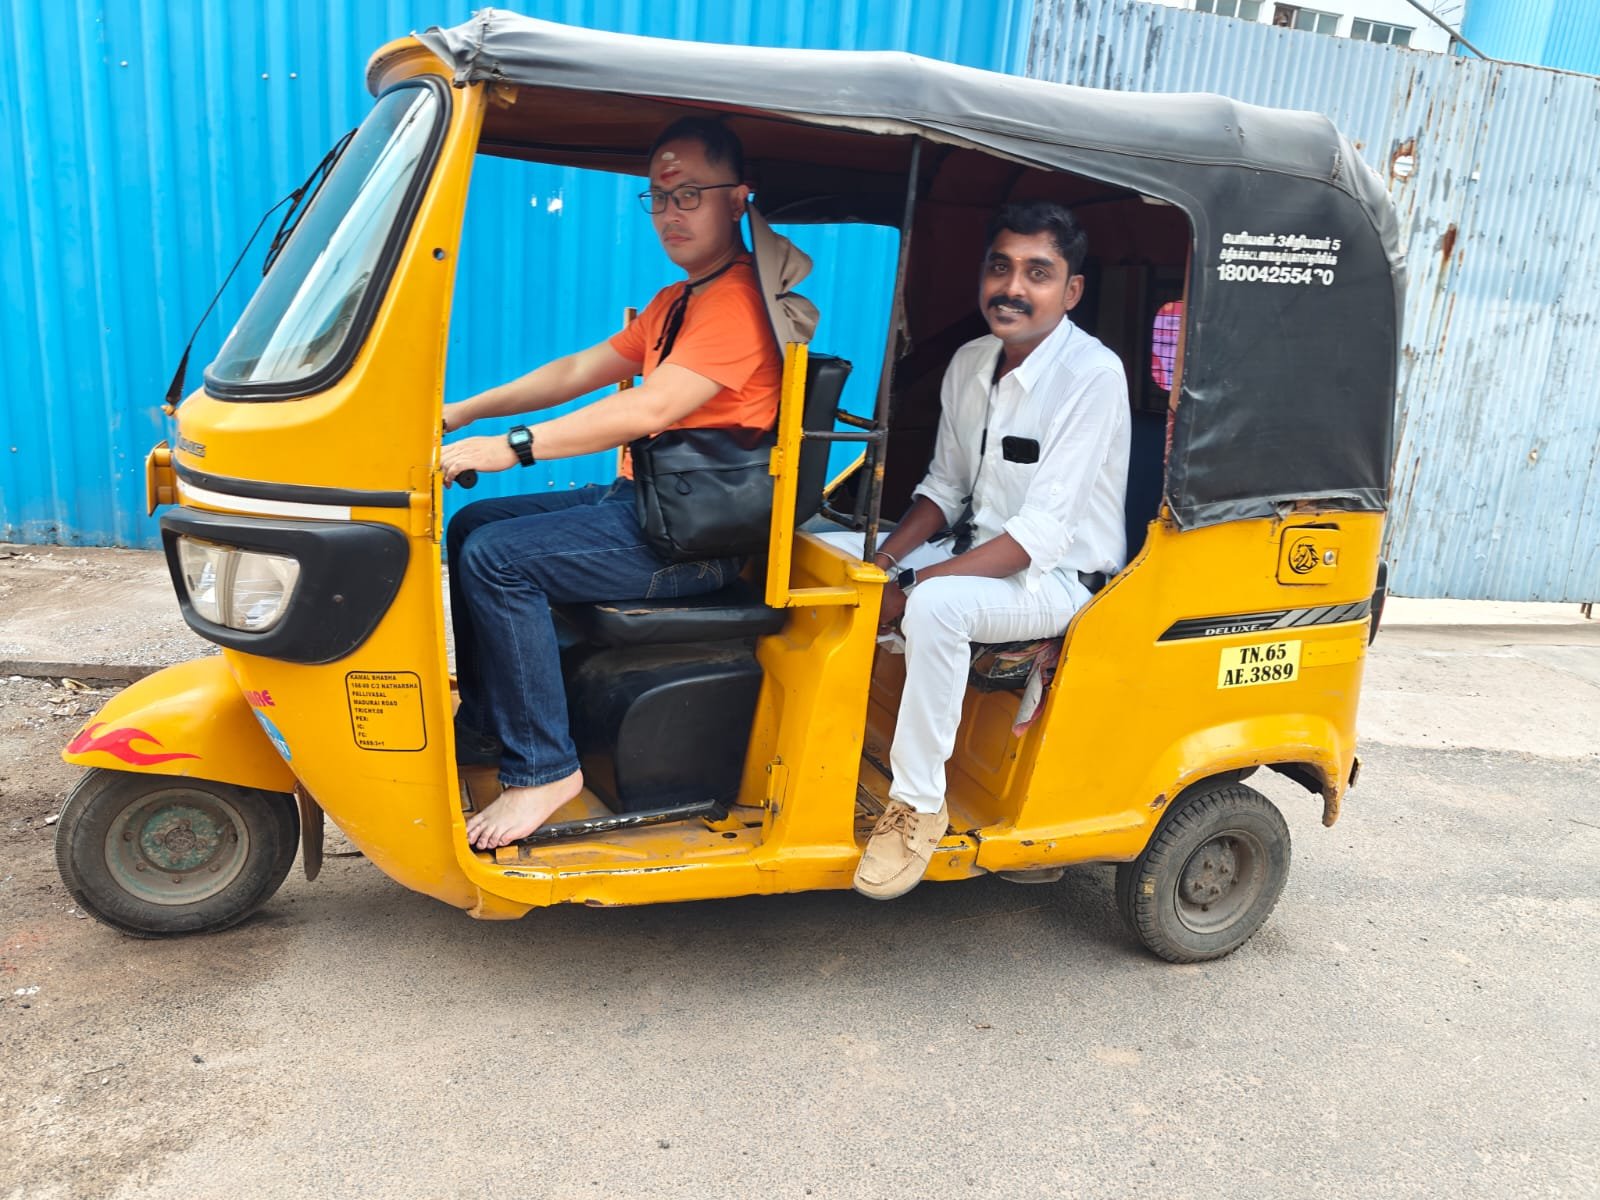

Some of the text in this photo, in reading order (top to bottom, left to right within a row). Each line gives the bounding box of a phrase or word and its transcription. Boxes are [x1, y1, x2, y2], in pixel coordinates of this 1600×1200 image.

[1205, 624, 1260, 636] DELUXE
[1240, 643, 1287, 665] TN.65
[1223, 663, 1294, 686] AE.3889
